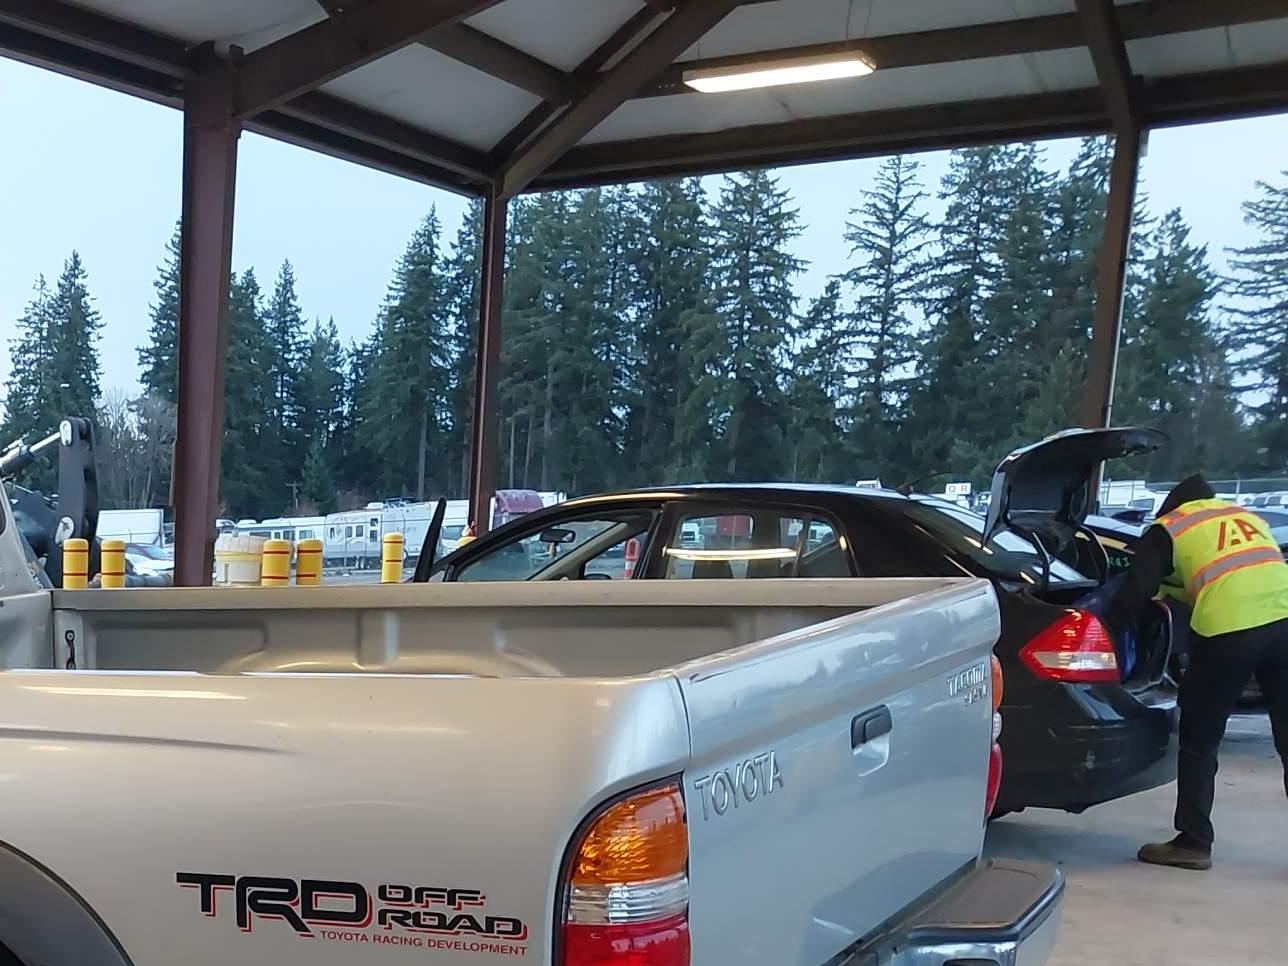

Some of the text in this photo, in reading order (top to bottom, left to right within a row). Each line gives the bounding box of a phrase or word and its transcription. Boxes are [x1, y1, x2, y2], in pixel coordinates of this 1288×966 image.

[1217, 518, 1267, 551] IAA
[694, 750, 784, 822] TOYOTA
[176, 872, 373, 938] TRD
[378, 884, 486, 910] OFF
[378, 908, 528, 941] ROAD
[320, 930, 528, 956] TOYOTA RACING DEVELOPMENT
